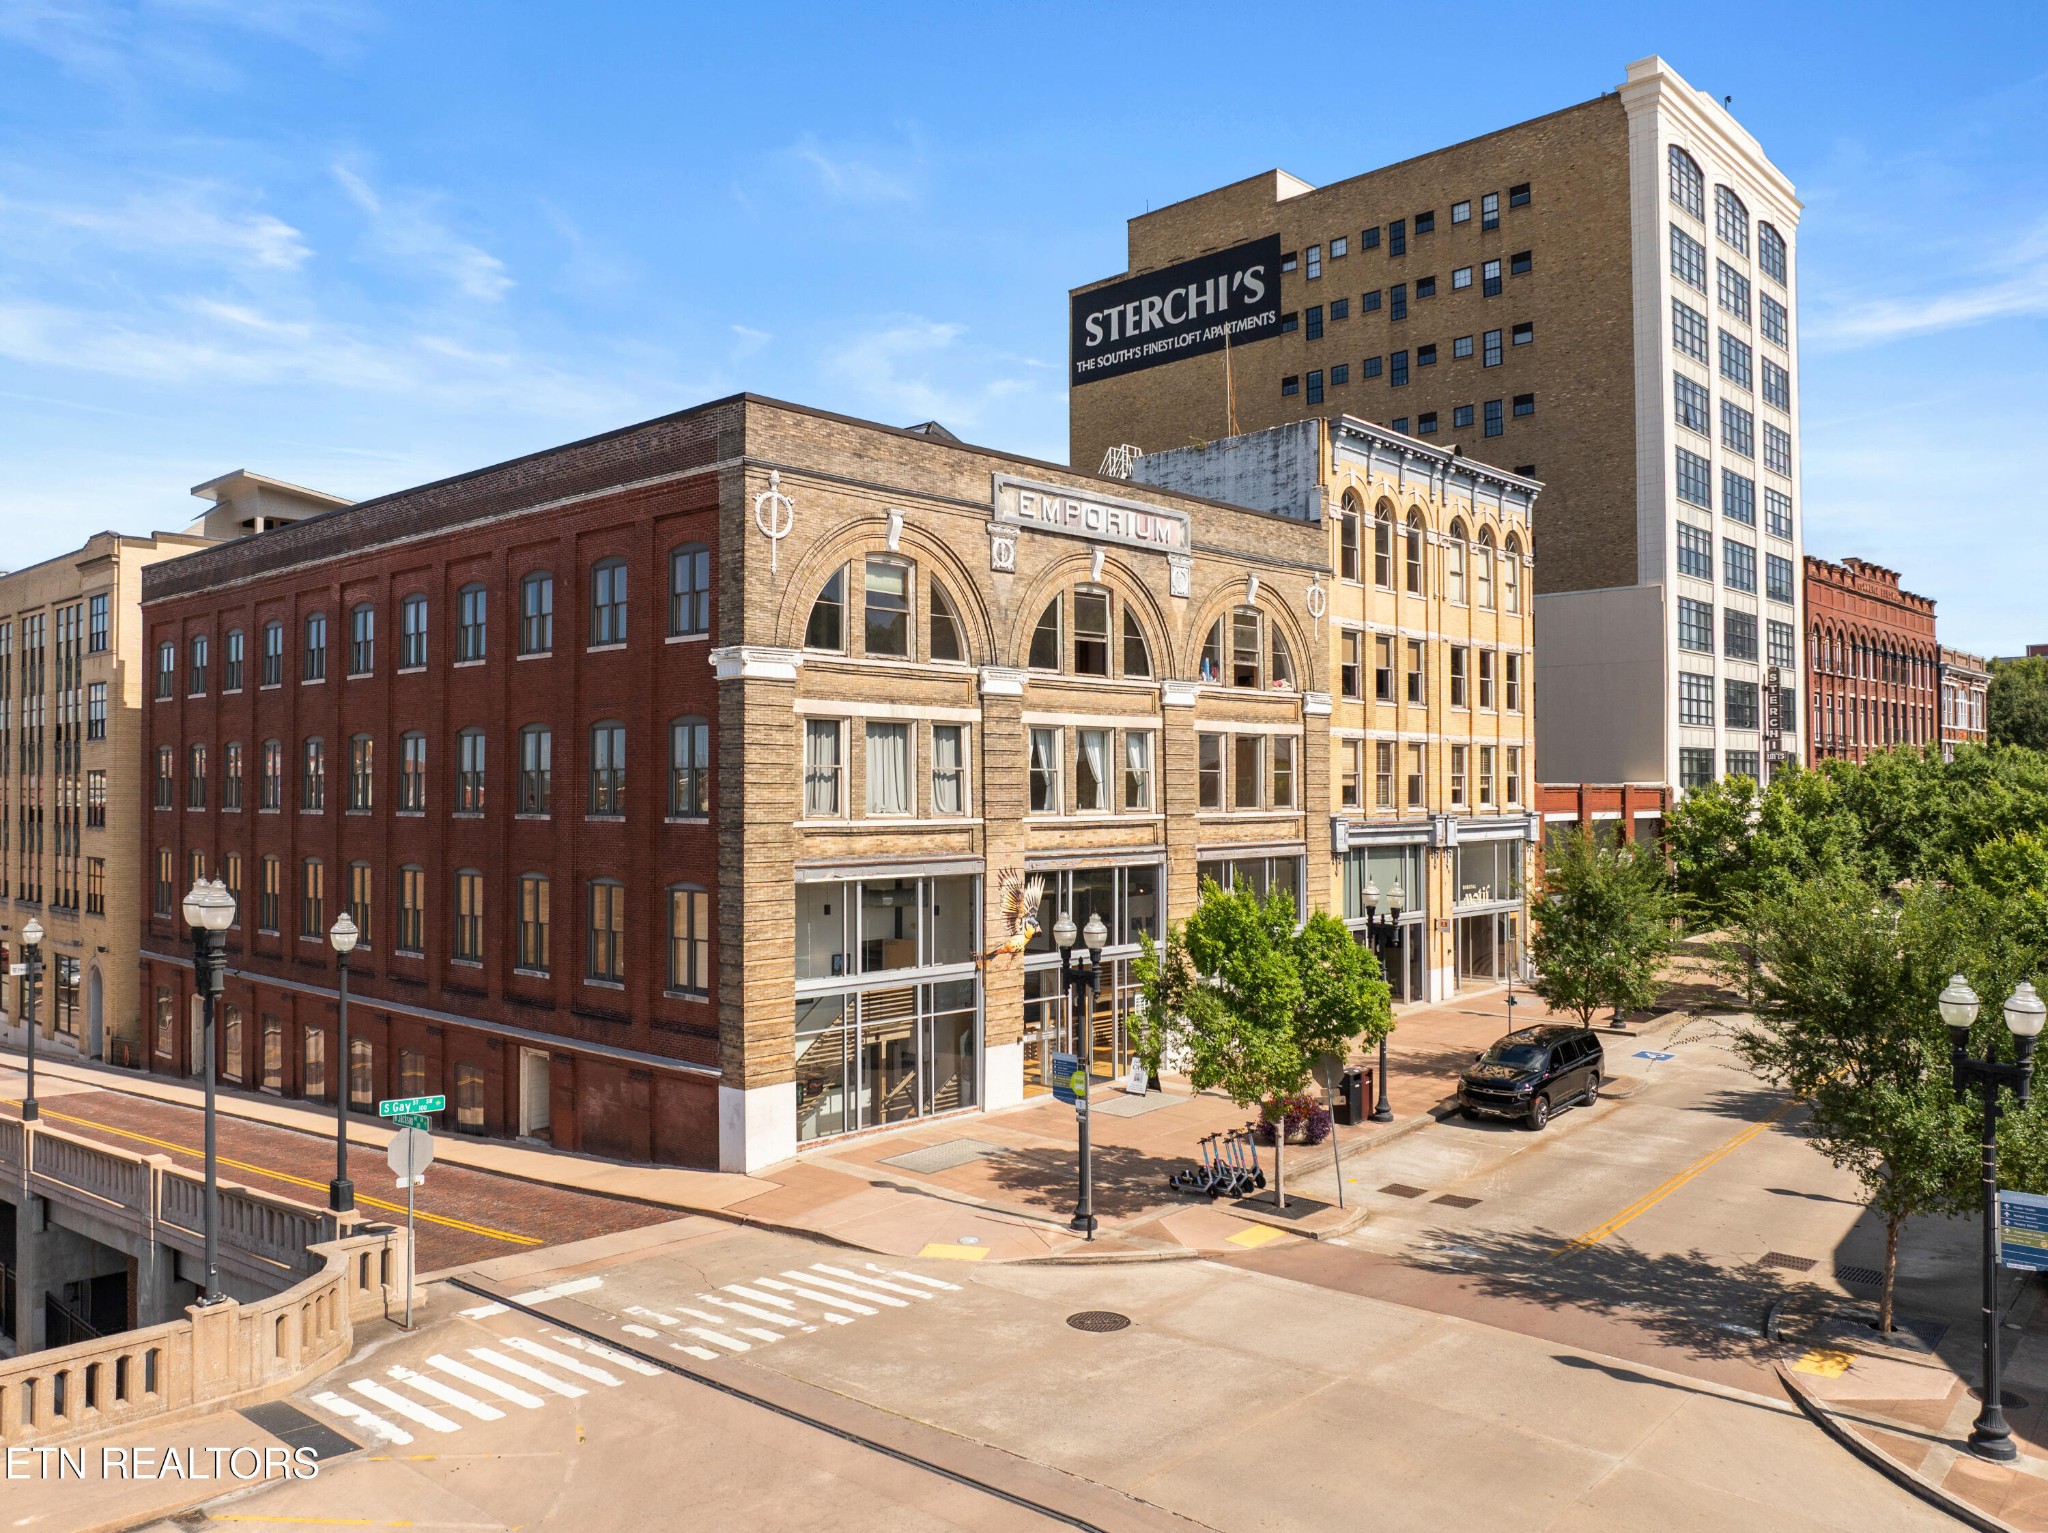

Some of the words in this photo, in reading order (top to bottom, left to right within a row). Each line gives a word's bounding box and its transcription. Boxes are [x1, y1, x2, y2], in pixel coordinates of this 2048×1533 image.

[1085, 265, 1265, 347] STERCHI'S
[1076, 358, 1096, 373] THE
[1097, 346, 1142, 368] SOUTH'S
[1143, 338, 1174, 356] FINEST
[1174, 330, 1202, 348] LOFT
[1202, 310, 1276, 341] APARTMENTS
[1018, 491, 1171, 544] EMPORIUM
[1769, 673, 1779, 750] STERCHI
[1766, 752, 1785, 760] LOFTS
[384, 1103, 390, 1113] S
[392, 1101, 411, 1113] Gay
